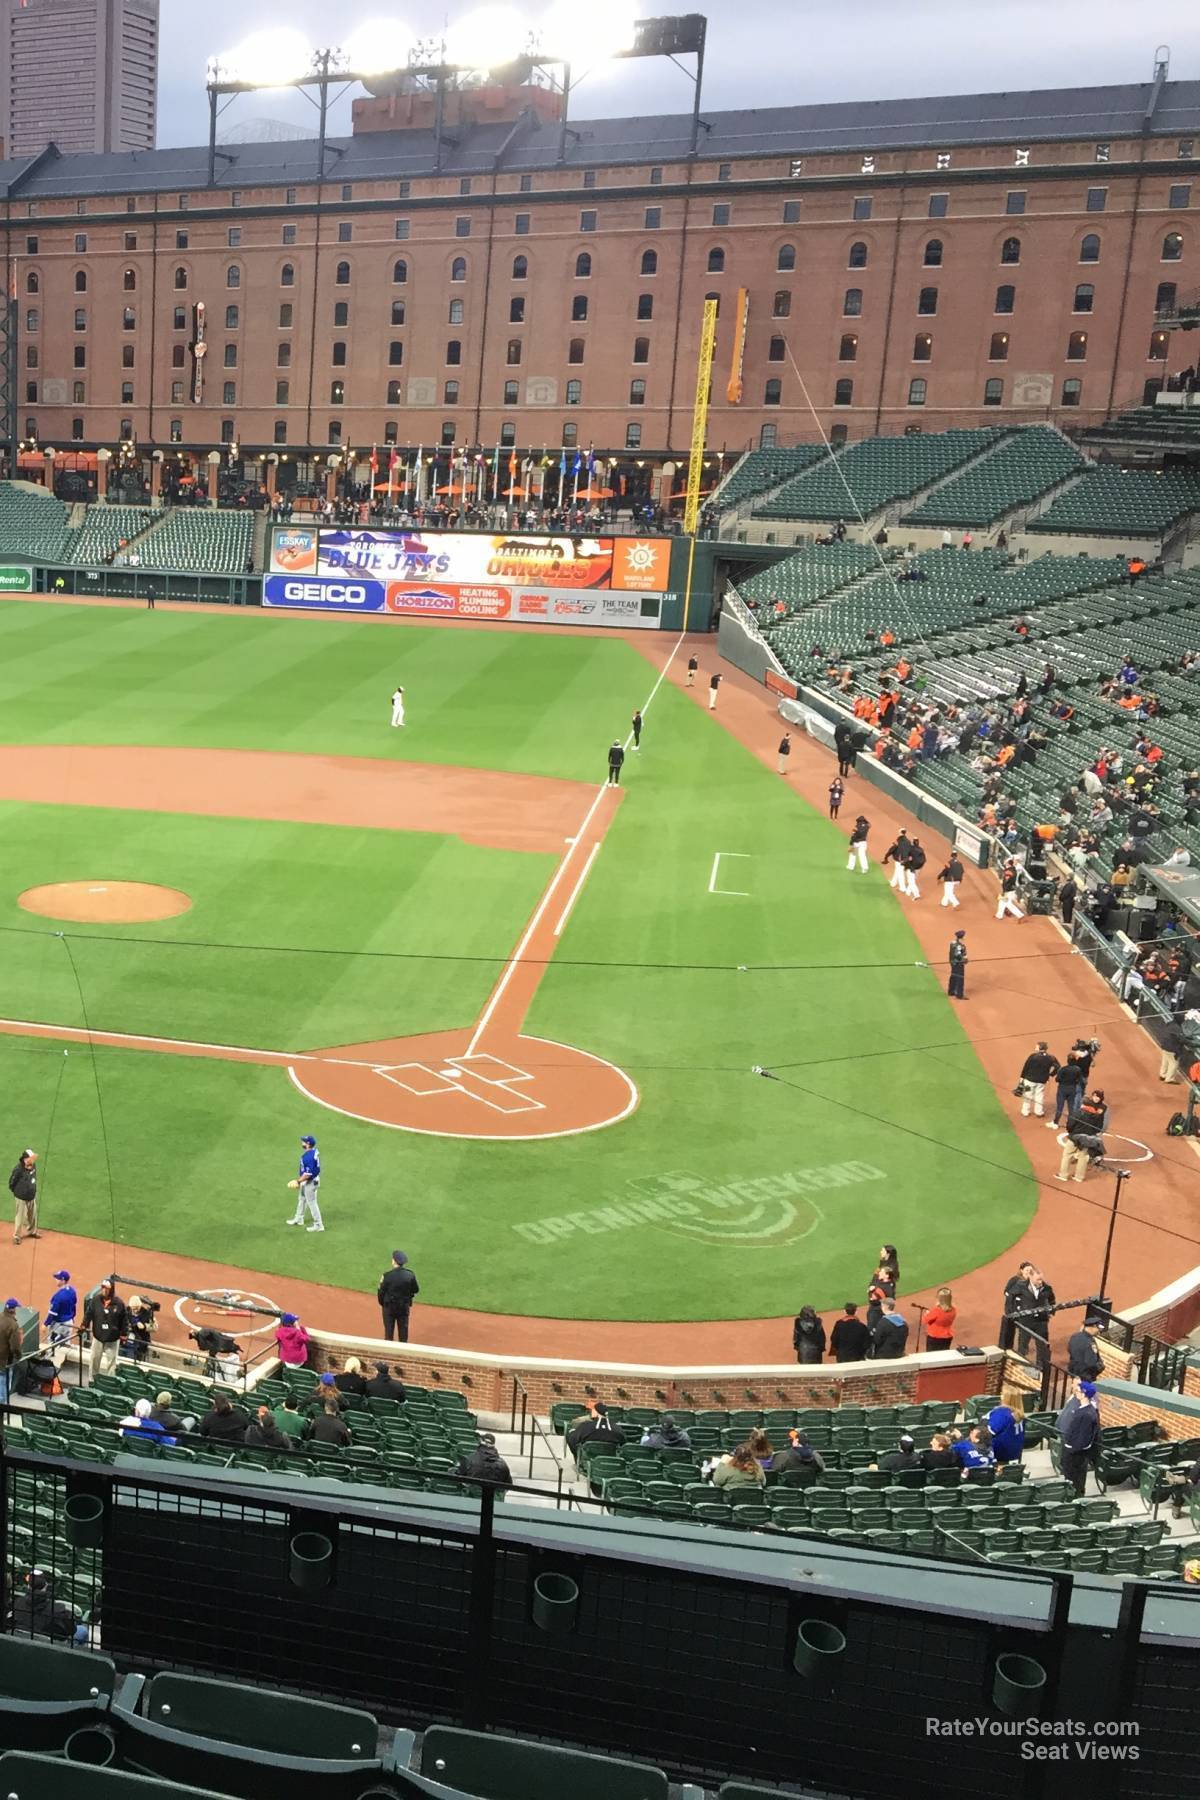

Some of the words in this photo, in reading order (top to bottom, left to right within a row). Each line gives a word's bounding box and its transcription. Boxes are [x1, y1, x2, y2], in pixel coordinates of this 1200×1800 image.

[279, 536, 310, 546] ESSKAY
[497, 547, 560, 558] BALTIMORE
[327, 550, 382, 569] BLUE
[387, 552, 451, 573] JAYS
[0, 576, 26, 584] Rental
[284, 583, 366, 604] GEICO
[459, 588, 499, 598] HEATING
[396, 597, 454, 609] HORIZON
[459, 597, 506, 607] PLUMBING
[602, 600, 616, 608] THE
[617, 600, 638, 609] TEAM
[458, 605, 499, 615] COOLING
[511, 1199, 702, 1245] OPENING
[689, 1160, 889, 1210] WEEKEND
